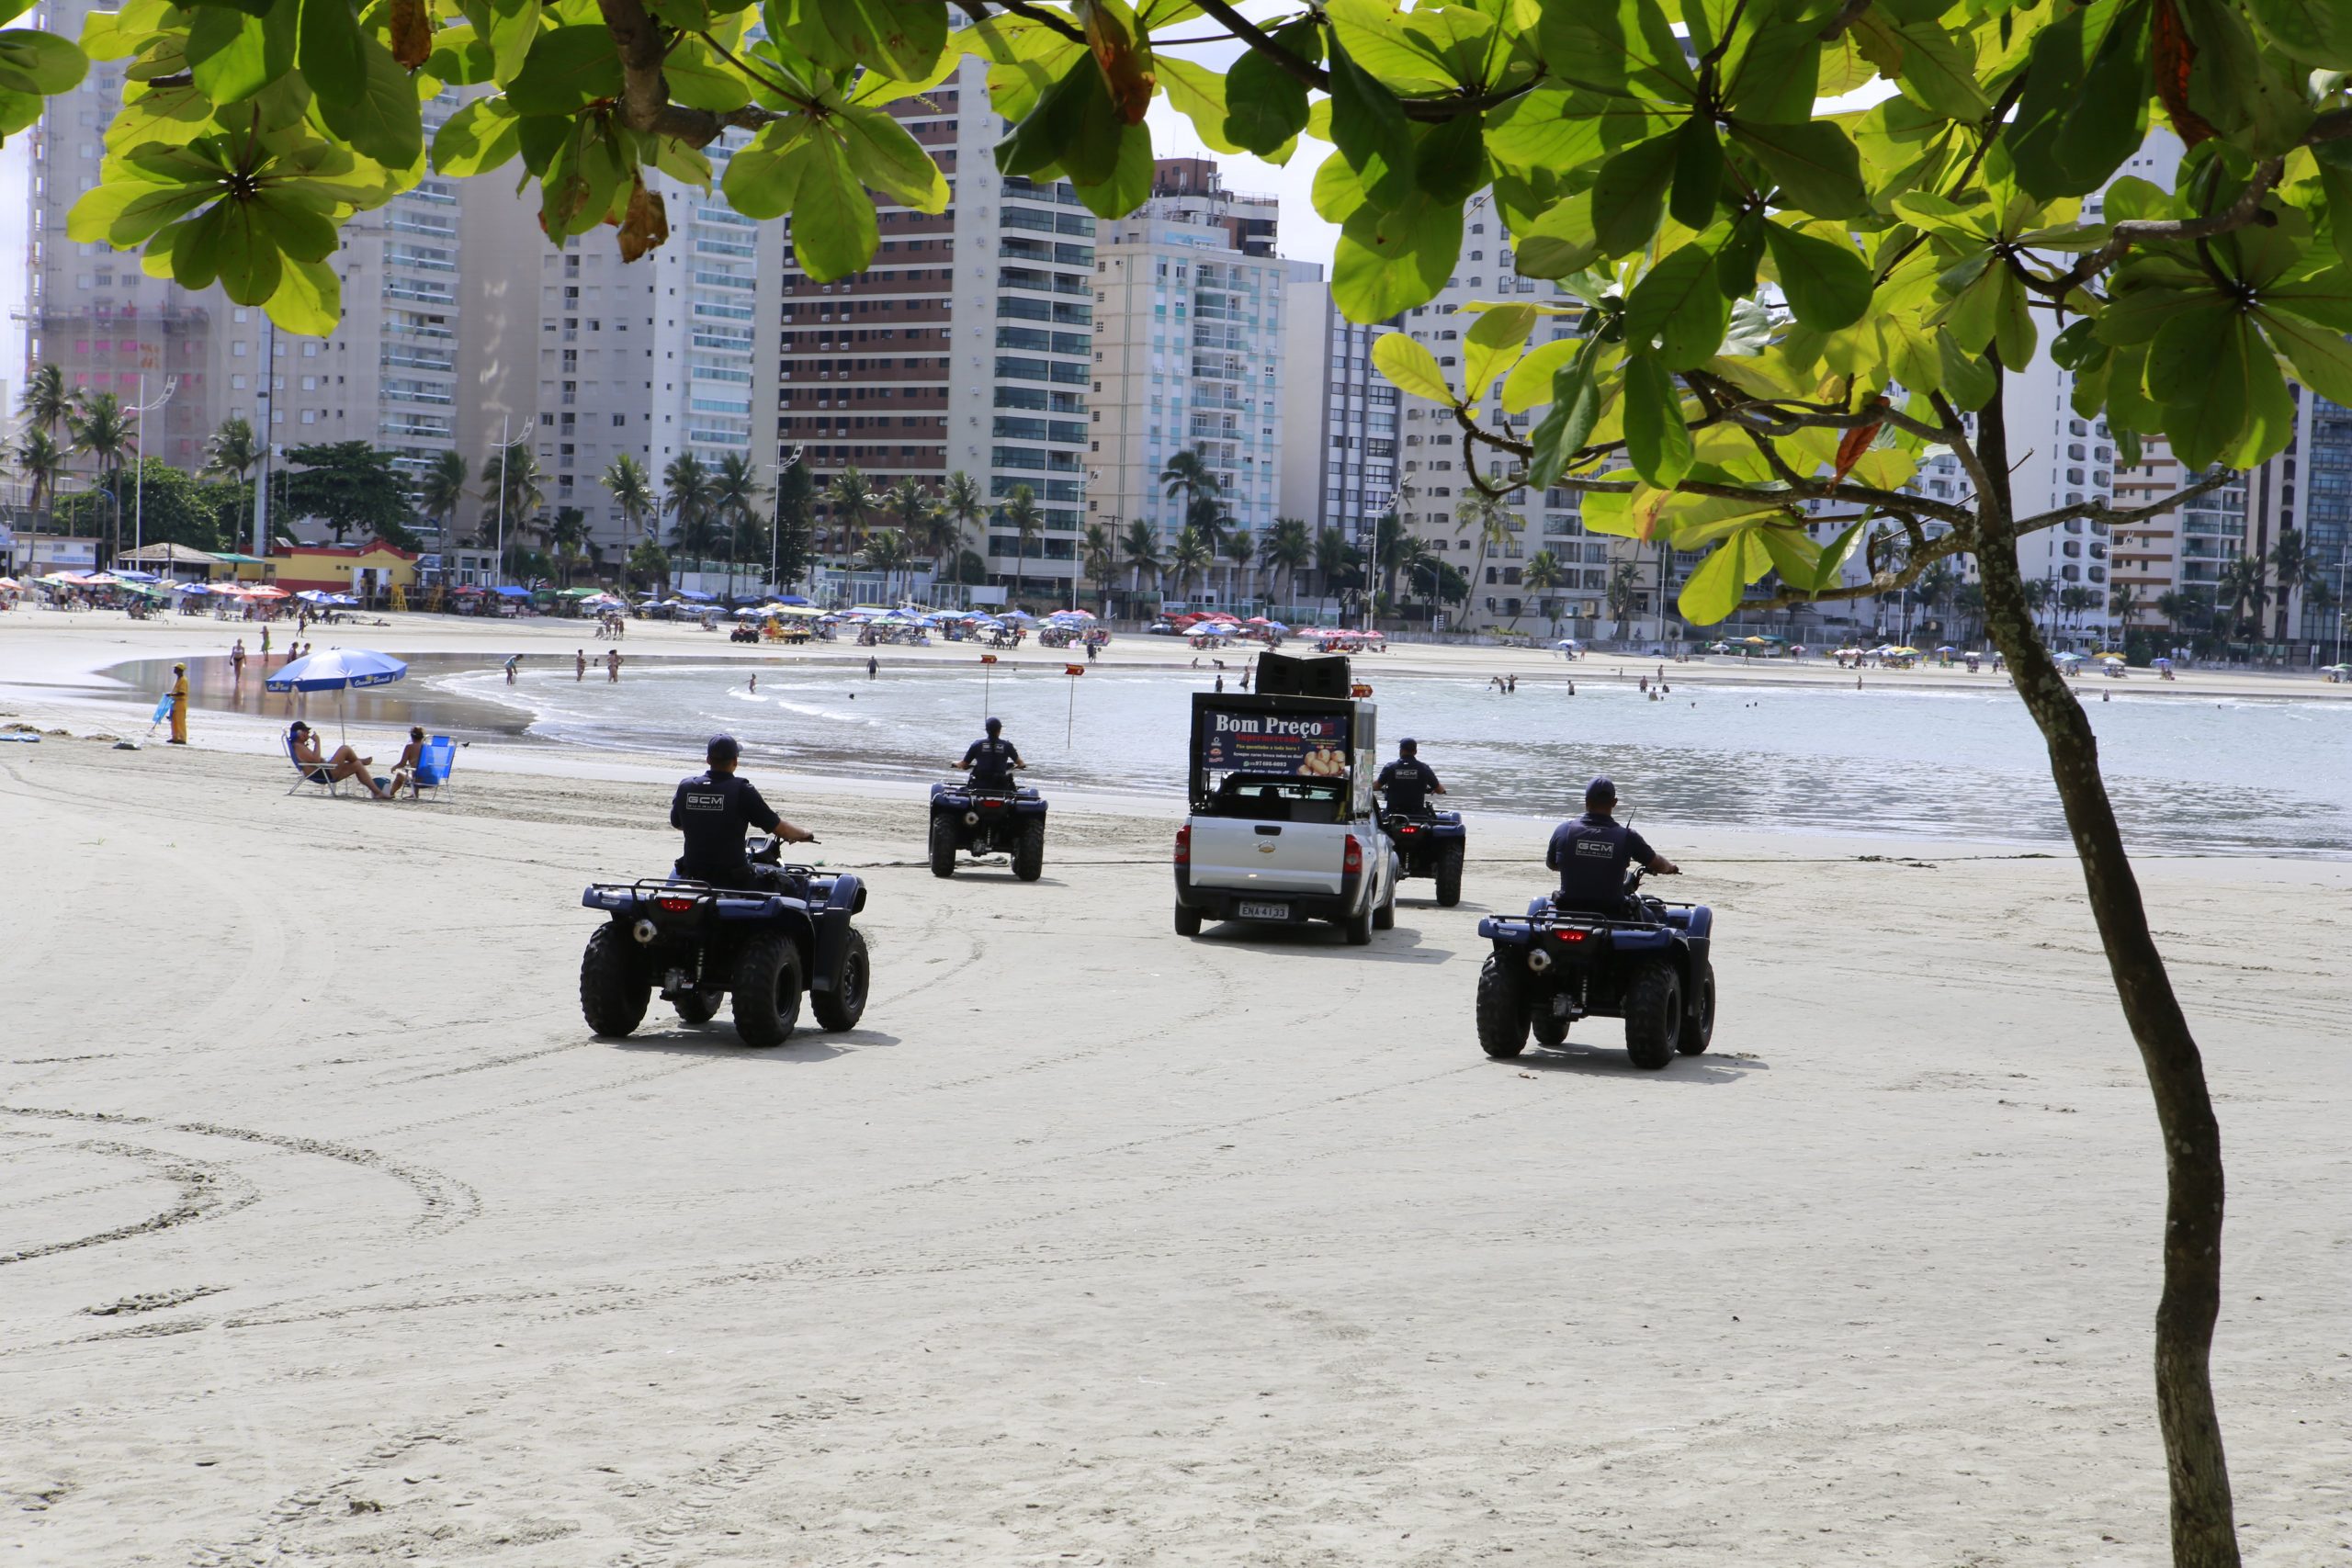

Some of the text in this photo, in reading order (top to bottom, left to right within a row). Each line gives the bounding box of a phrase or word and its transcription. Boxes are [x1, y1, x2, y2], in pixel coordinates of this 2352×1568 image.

[1216, 714, 1322, 739] Bom Preço
[688, 795, 723, 805] GCM
[1578, 842, 1613, 852] GCM
